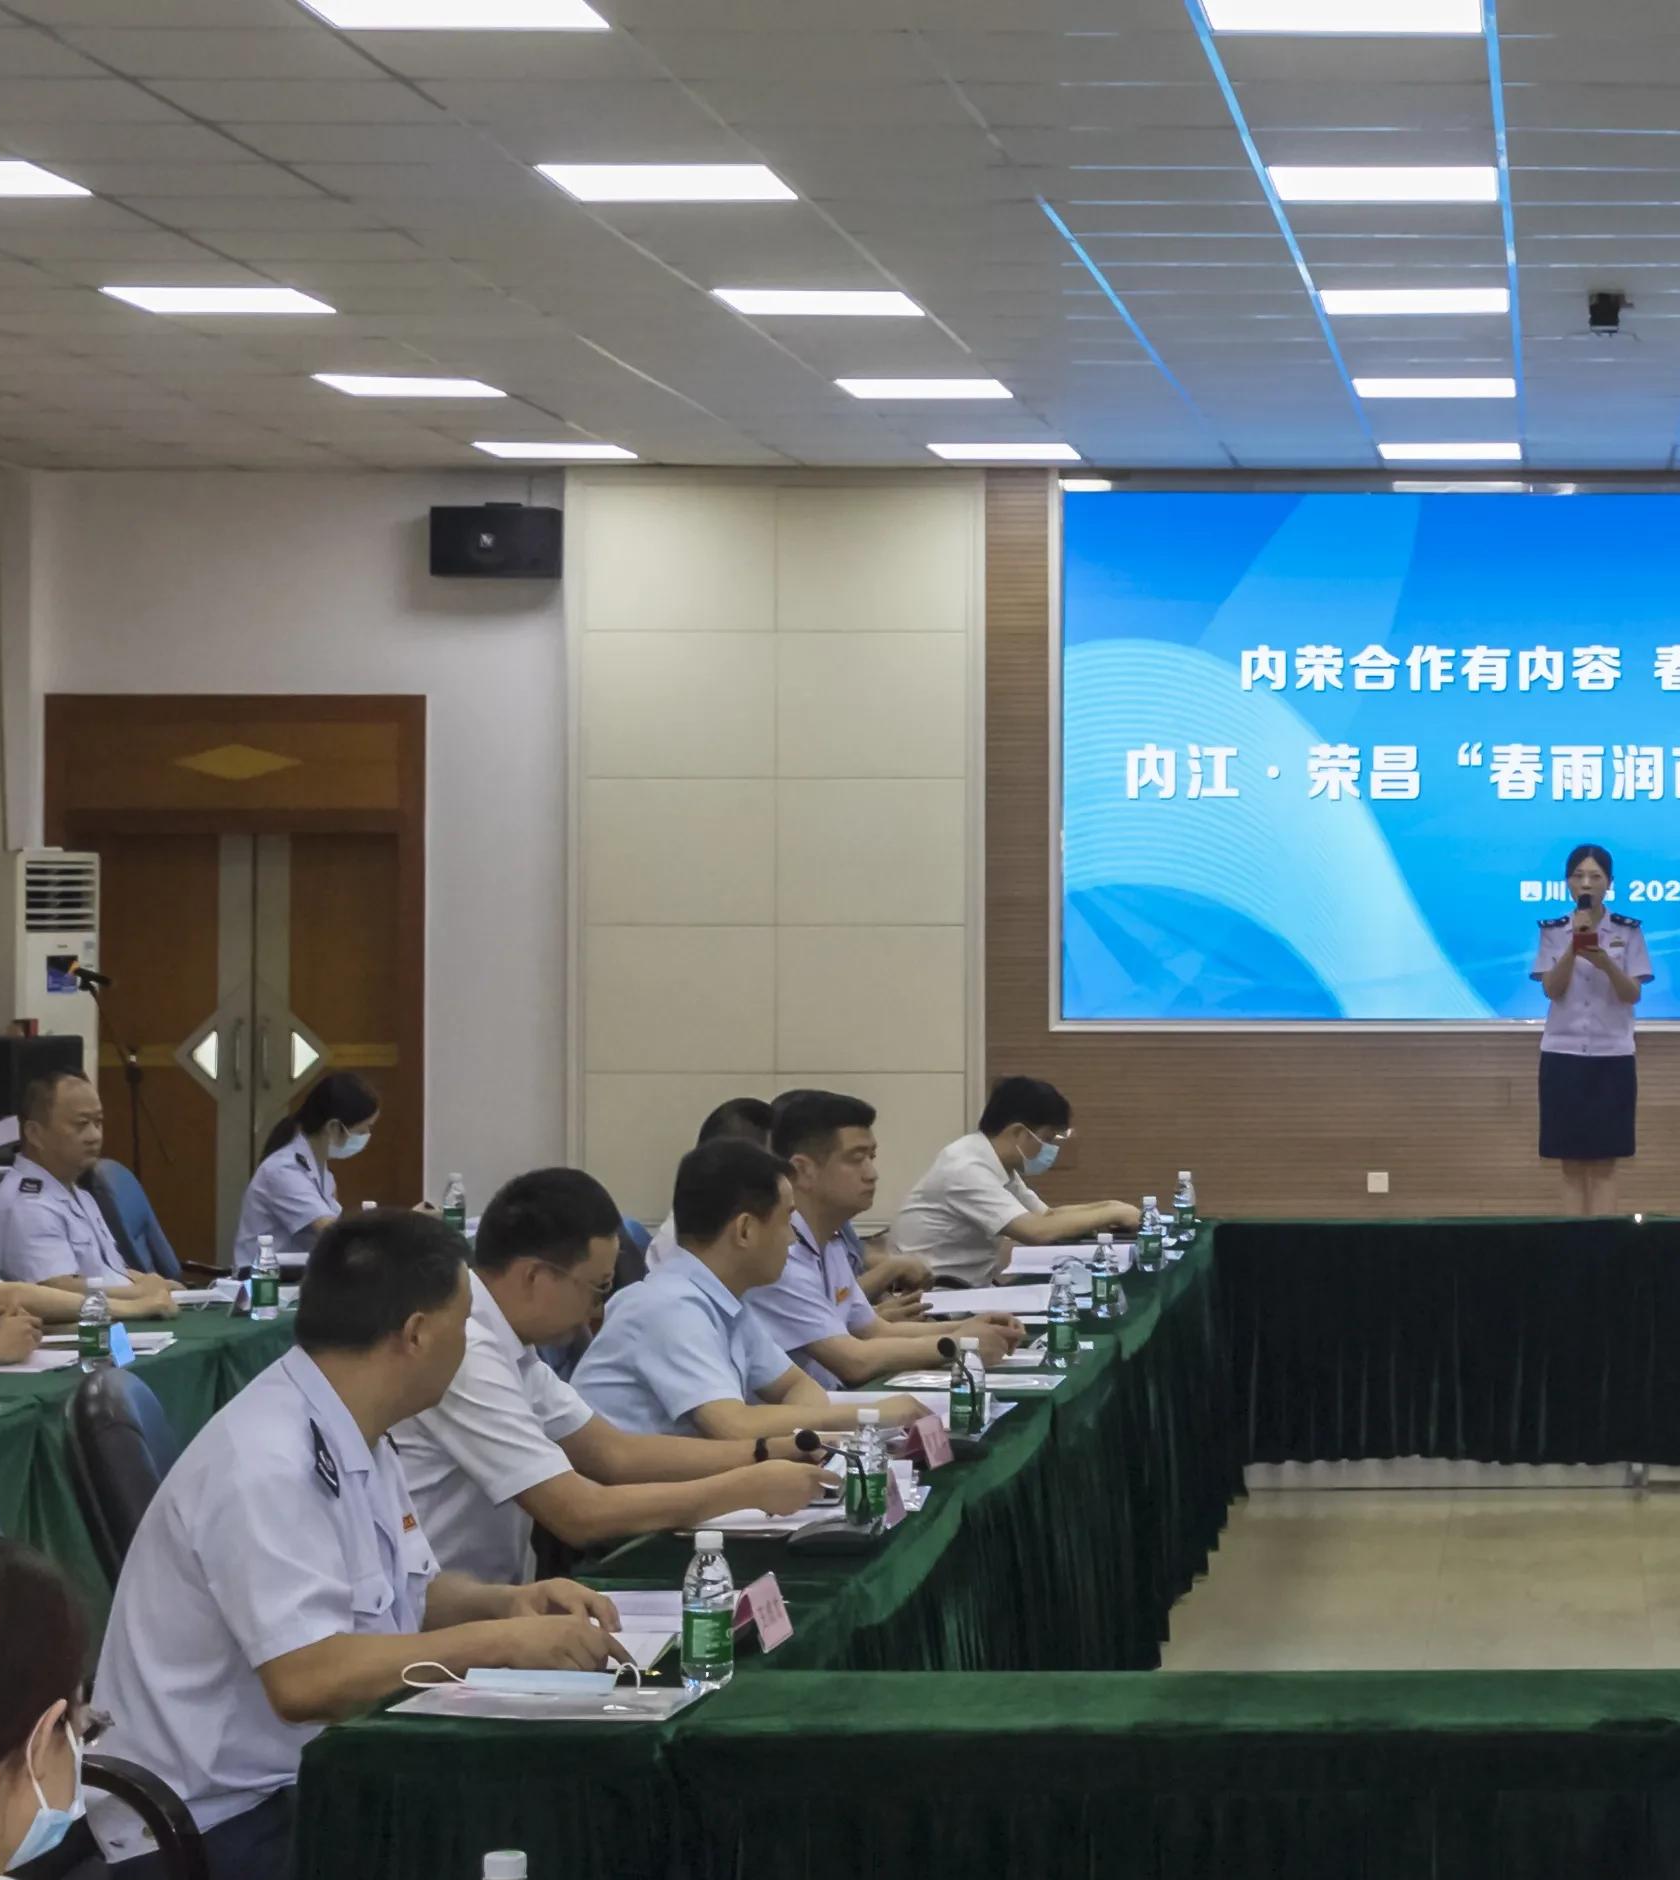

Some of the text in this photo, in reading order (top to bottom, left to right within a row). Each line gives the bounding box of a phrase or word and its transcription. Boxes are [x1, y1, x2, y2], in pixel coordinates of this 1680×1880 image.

[1239, 643, 1622, 692] 内荣合作有内容
[1519, 879, 1616, 902] 四川
